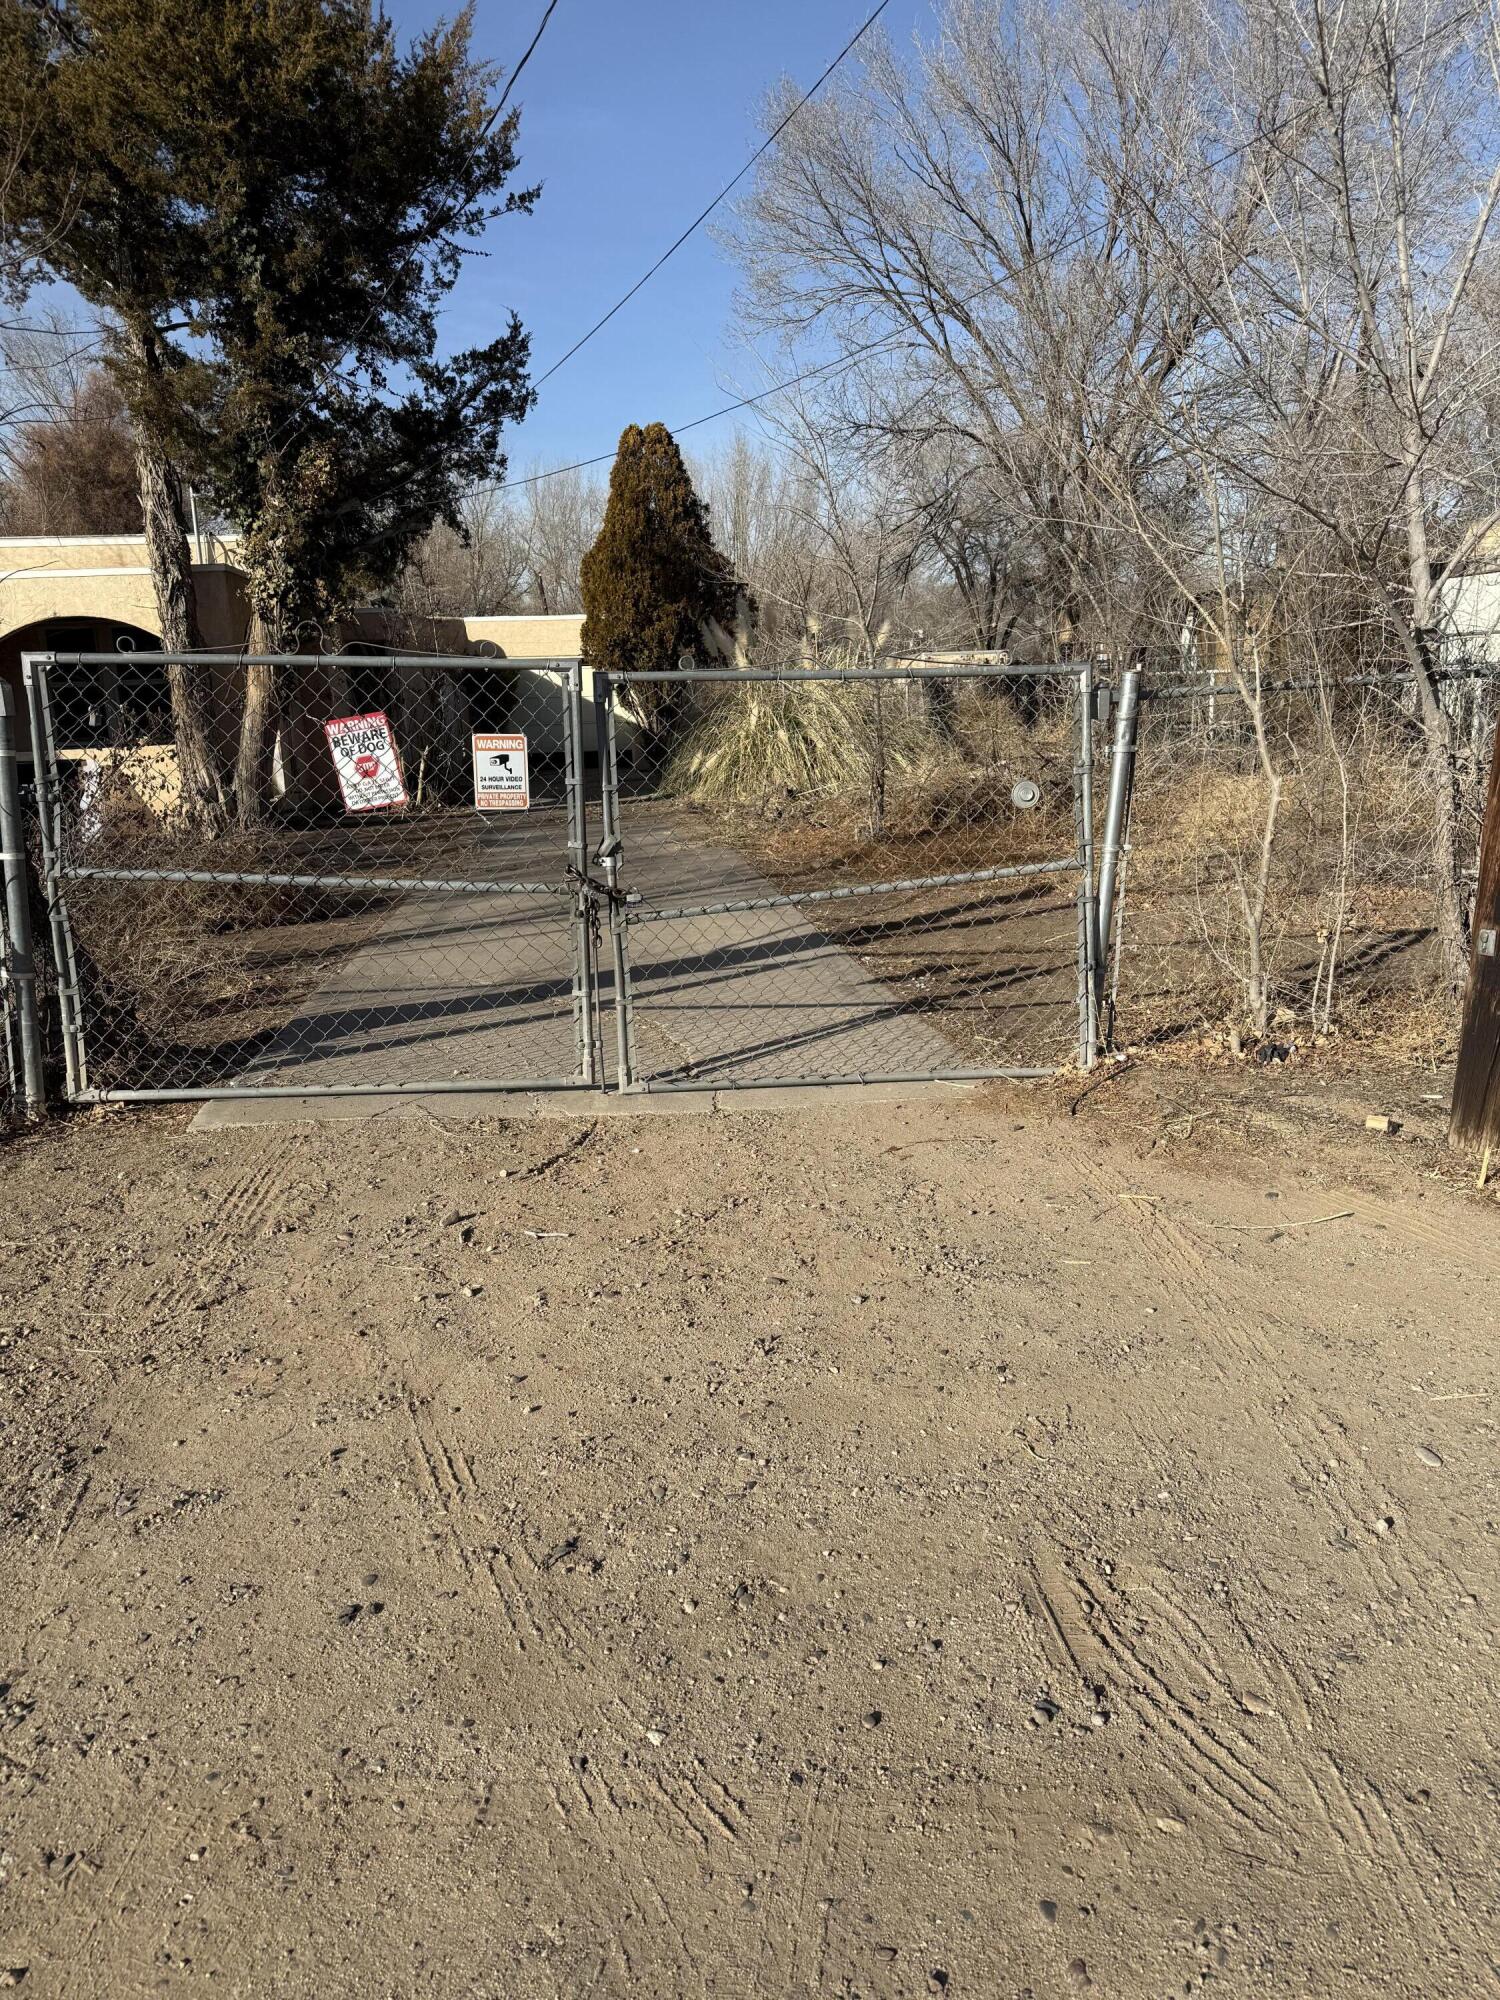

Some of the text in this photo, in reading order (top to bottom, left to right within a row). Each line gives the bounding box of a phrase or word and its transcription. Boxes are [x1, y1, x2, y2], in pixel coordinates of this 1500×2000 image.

[325, 715, 385, 736] WARNING
[332, 727, 387, 748] BEWARE
[477, 739, 524, 749] WARNING
[340, 740, 385, 757] OF DOG
